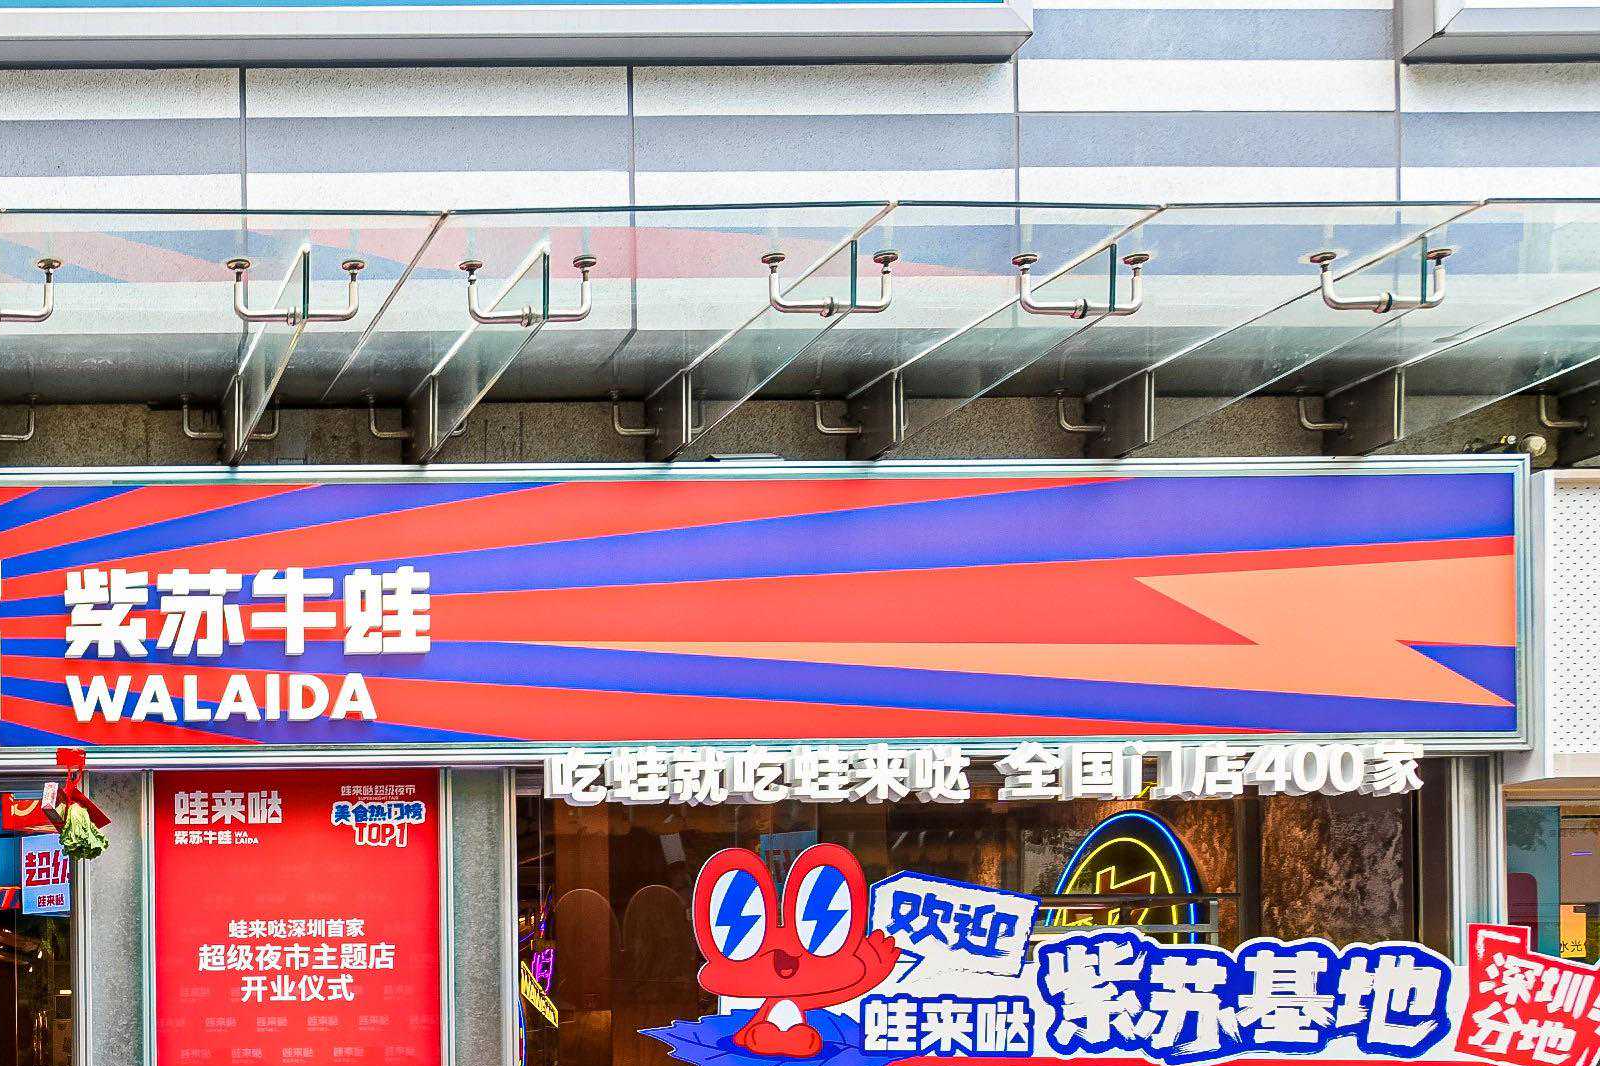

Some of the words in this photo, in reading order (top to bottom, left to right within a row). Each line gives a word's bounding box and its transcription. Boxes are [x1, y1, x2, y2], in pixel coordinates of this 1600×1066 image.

[64, 566, 431, 658] 紫苏牛蛙
[65, 672, 378, 722] WALAIDA
[547, 745, 971, 803] 吃蛙就吃蛙来哒
[998, 742, 1425, 798] 全国门店400家
[174, 789, 283, 825] 蛙来哒
[174, 830, 233, 844] 紫苏牛蛙
[355, 823, 406, 846] TOP1
[228, 918, 365, 940] 蛙来哒深圳首家
[887, 890, 1020, 957] 欢迎
[198, 943, 396, 972] 超级夜市主题店
[240, 974, 356, 1003] 开业仪式
[1047, 939, 1443, 1055] 紫苏基地
[1478, 952, 1596, 1020] 深圳
[864, 998, 1030, 1052] 蛙来哒
[1468, 1001, 1577, 1065] 分地
